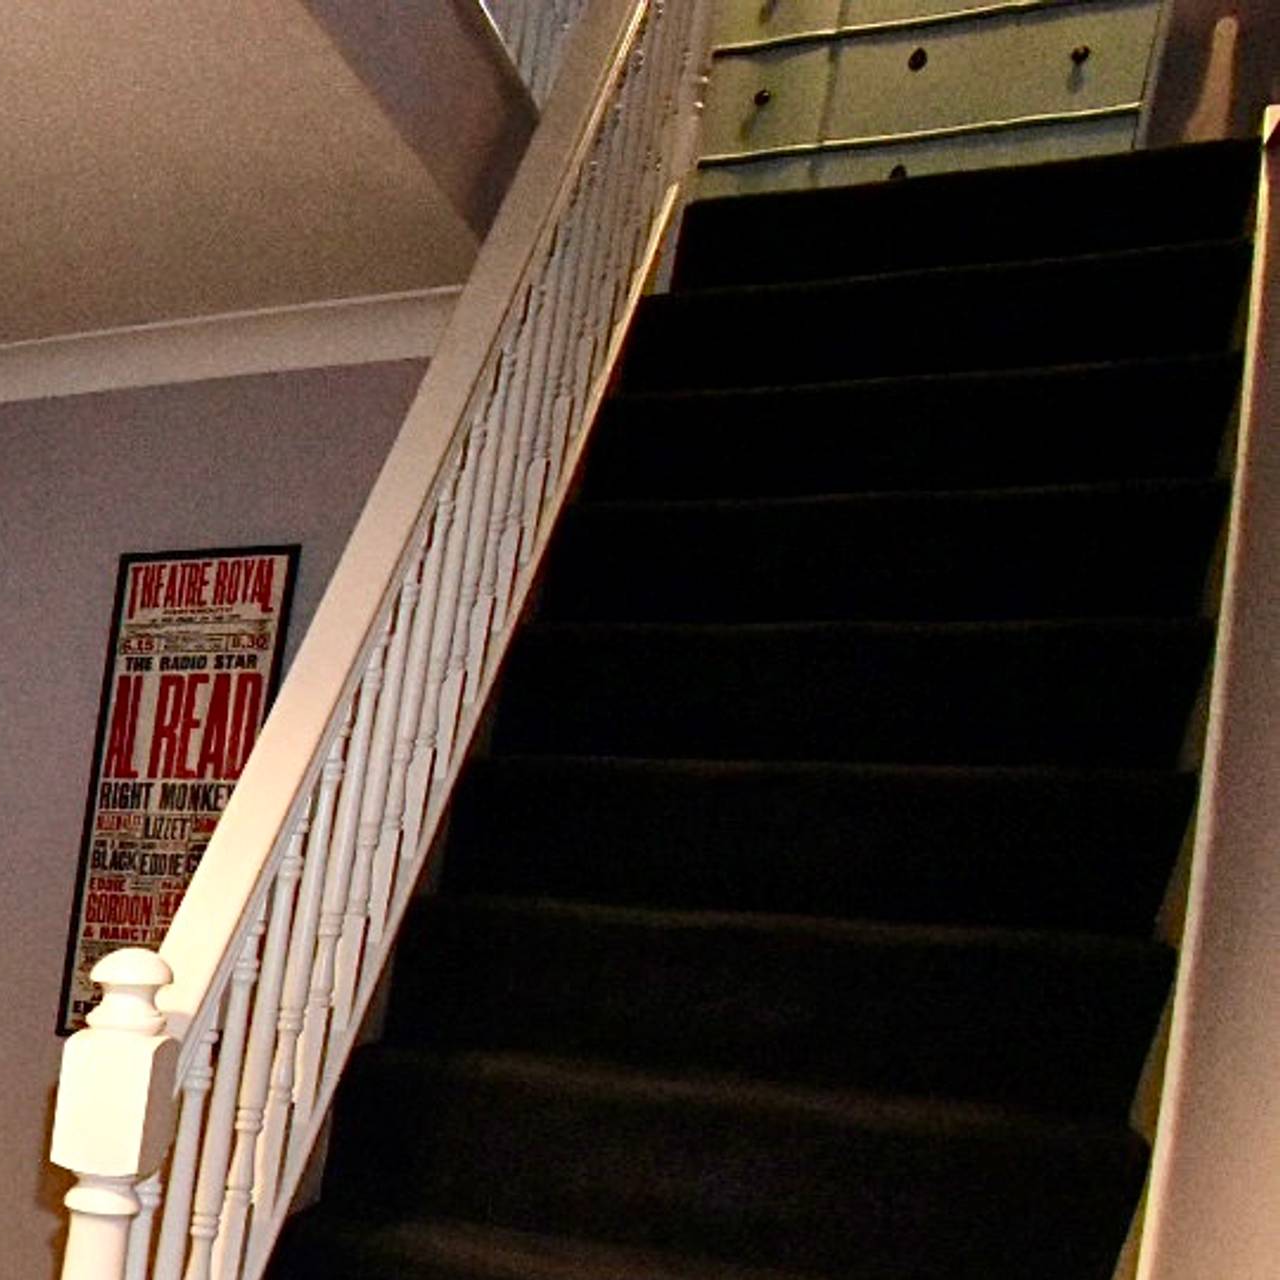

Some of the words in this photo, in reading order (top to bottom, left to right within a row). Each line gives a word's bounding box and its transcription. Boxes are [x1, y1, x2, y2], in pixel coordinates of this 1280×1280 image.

[128, 563, 211, 619] THEATRE
[213, 558, 274, 613] ROYAL
[125, 657, 152, 671] THE
[159, 655, 207, 671] RADIO
[214, 654, 257, 669] STAR
[102, 675, 143, 779] AL
[146, 672, 263, 780] READ
[99, 782, 154, 809] RIGHT
